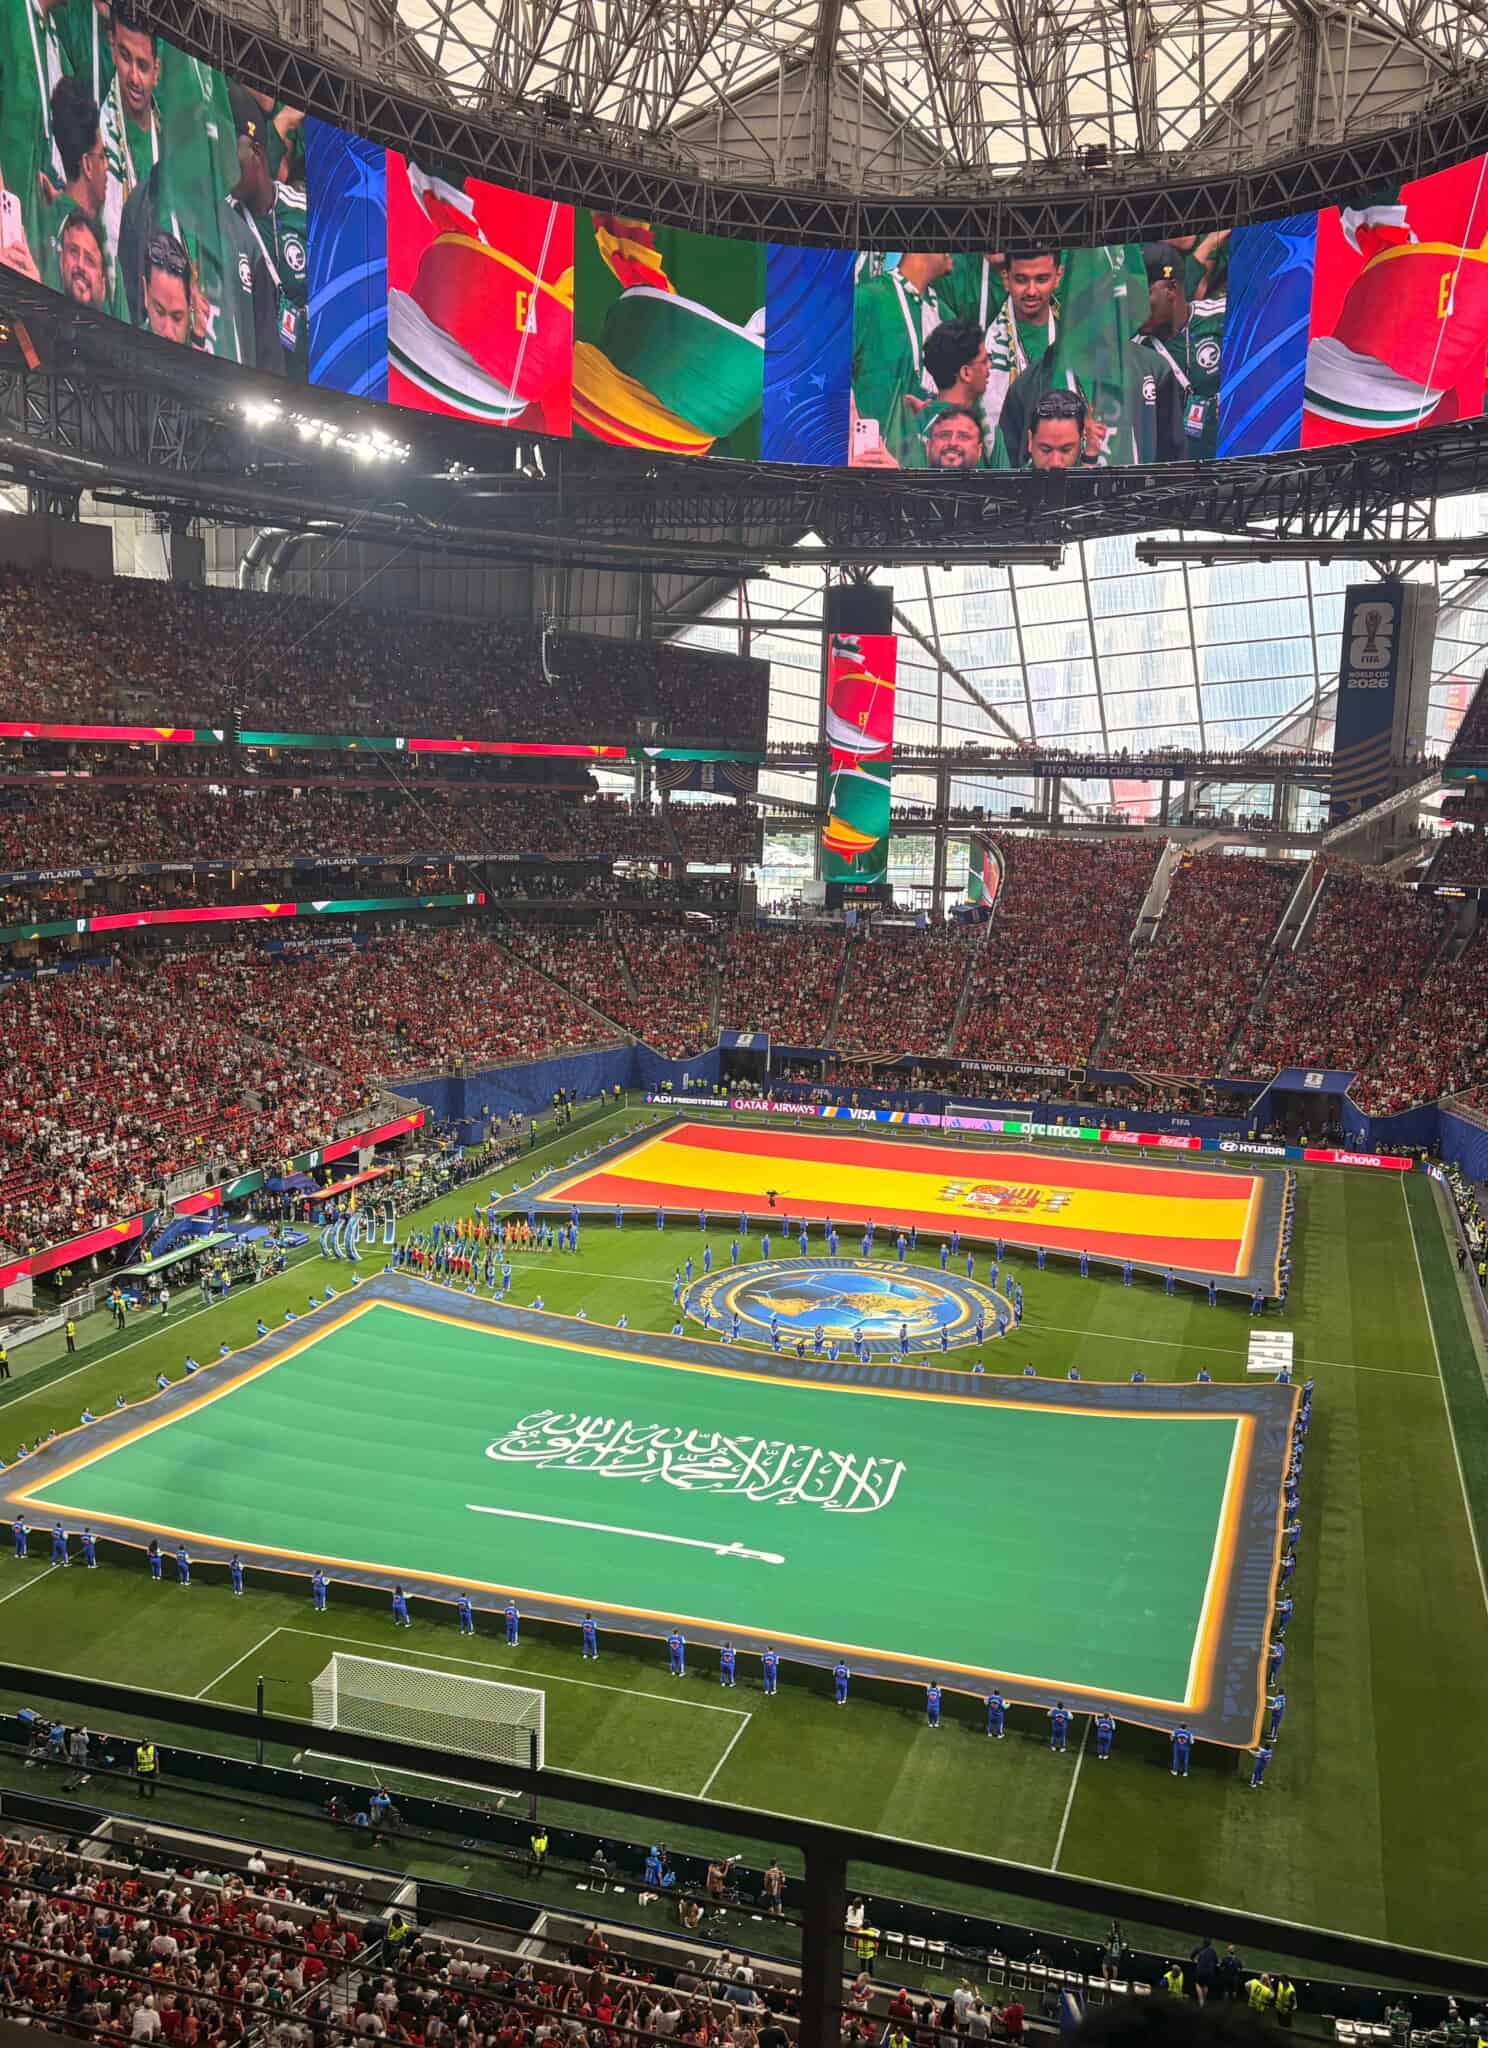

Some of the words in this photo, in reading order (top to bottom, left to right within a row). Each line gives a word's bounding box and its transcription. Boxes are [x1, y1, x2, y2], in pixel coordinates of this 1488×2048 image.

[1348, 679, 1390, 688] 2026
[1041, 765, 1065, 775] FIFA
[1067, 766, 1107, 776] WORLD
[1109, 766, 1132, 776] CUP
[1133, 767, 1174, 777] 2026
[314, 858, 359, 866] ATLANTA
[38, 869, 82, 880] ATLANTA
[960, 1061, 980, 1070] FIFA
[981, 1063, 1013, 1073] WORLD
[1014, 1066, 1033, 1074] CUP
[1033, 1068, 1066, 1077] 2026
[734, 1100, 769, 1111] QATAR
[772, 1102, 816, 1115] AIRWAYS
[848, 1108, 877, 1121] VISA
[1335, 1152, 1381, 1167] Lenovo
